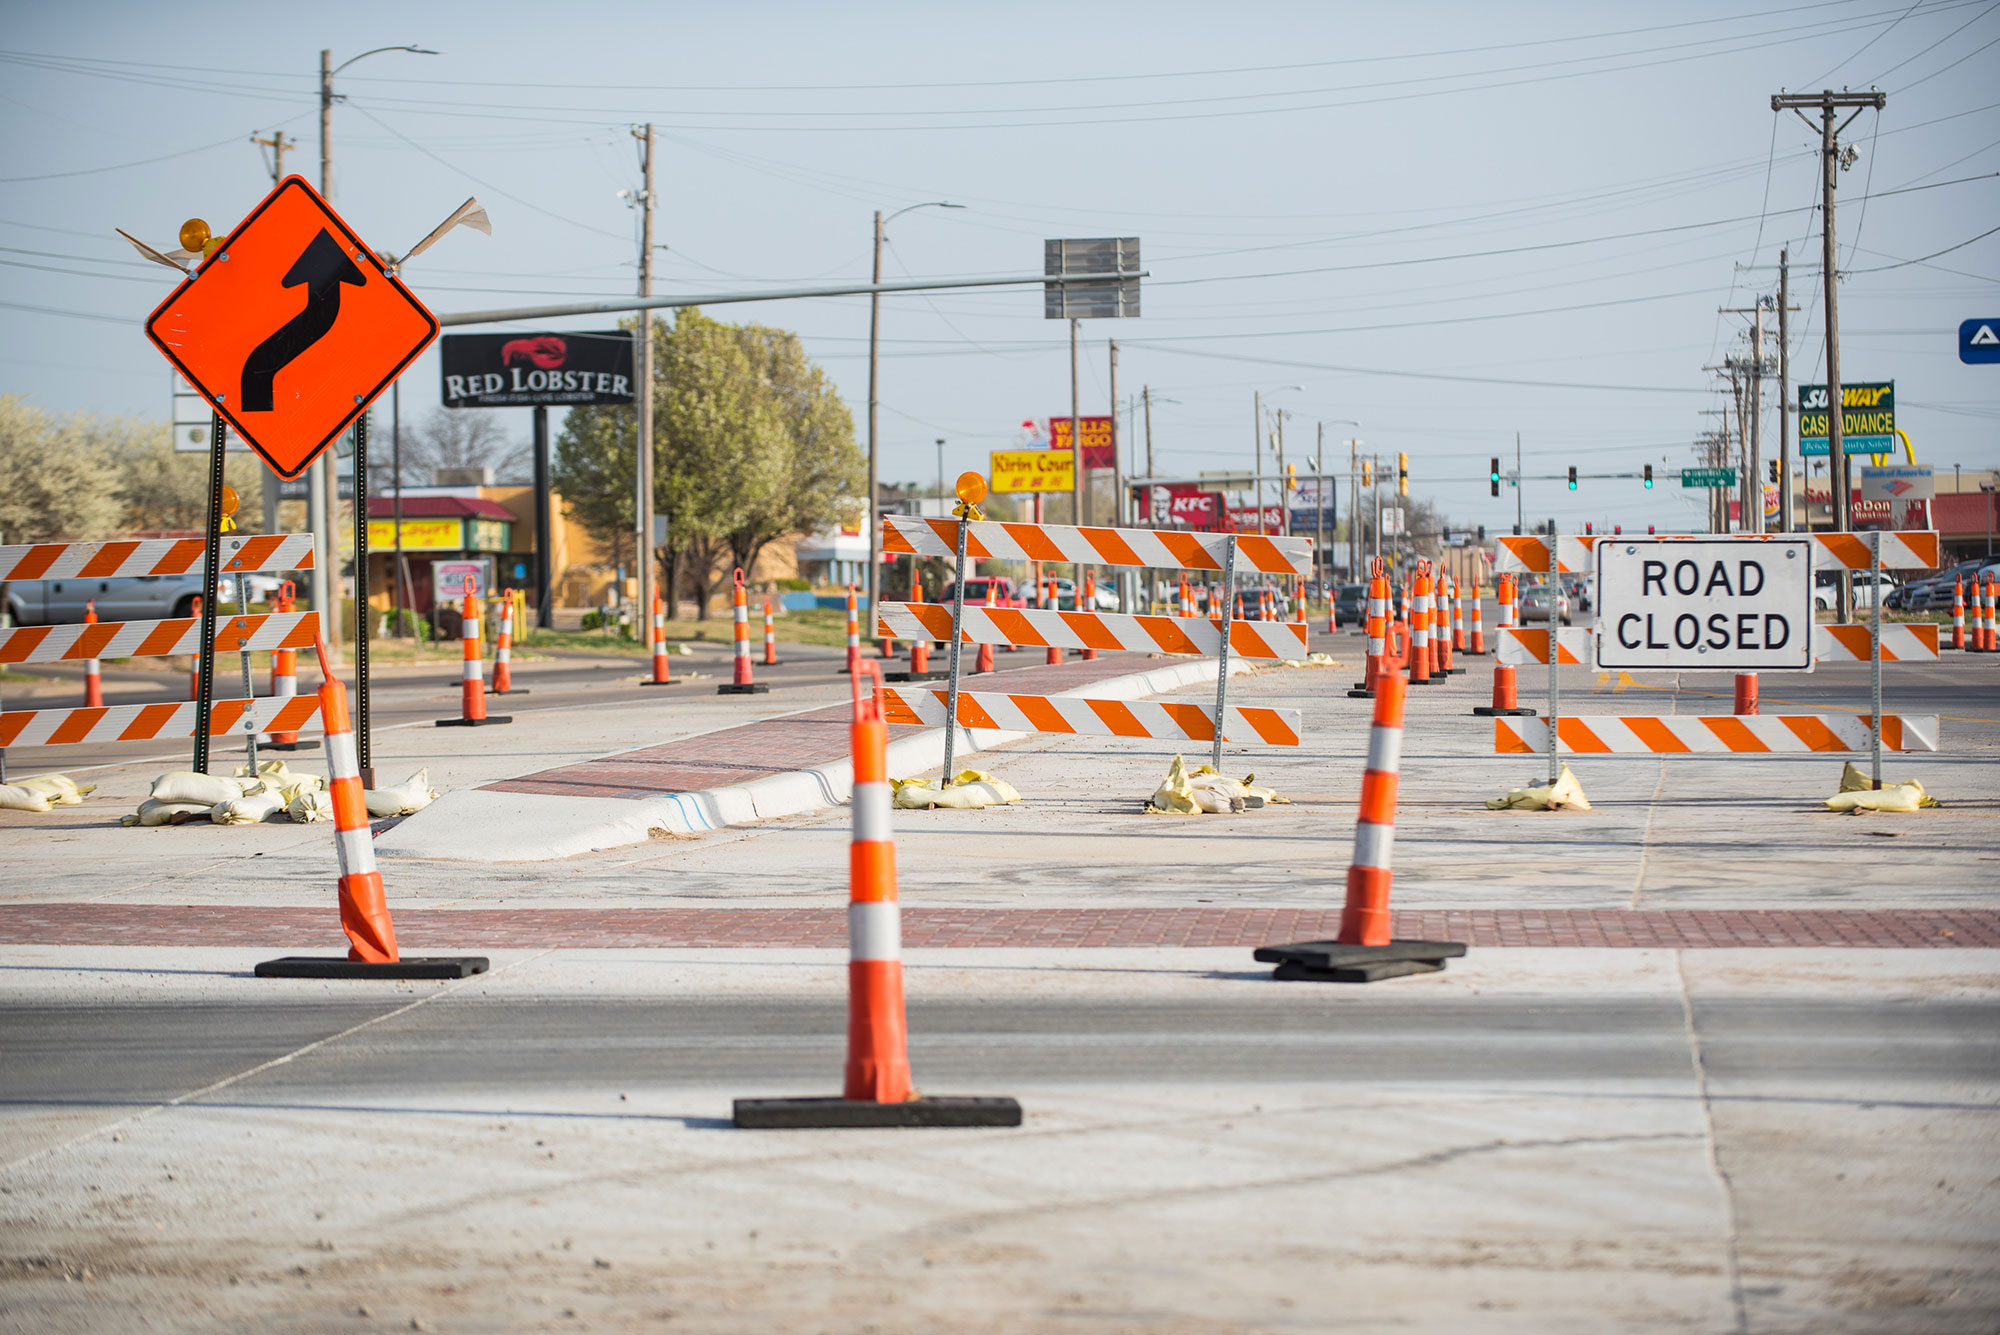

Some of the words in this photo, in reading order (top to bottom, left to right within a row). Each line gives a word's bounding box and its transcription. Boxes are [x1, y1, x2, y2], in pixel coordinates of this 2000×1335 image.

[446, 373, 504, 400] RED
[509, 367, 630, 397] LOBSTER
[1803, 386, 1891, 409] SUWAY
[1053, 420, 1113, 434] WLLS
[994, 454, 1033, 473] Kirin
[1036, 453, 1074, 473] Cour
[1863, 469, 1885, 477] Bank
[1897, 468, 1932, 477] America
[1173, 496, 1212, 512] KFC
[1642, 559, 1764, 597] ROAD
[1617, 612, 1790, 650] CLOSED
